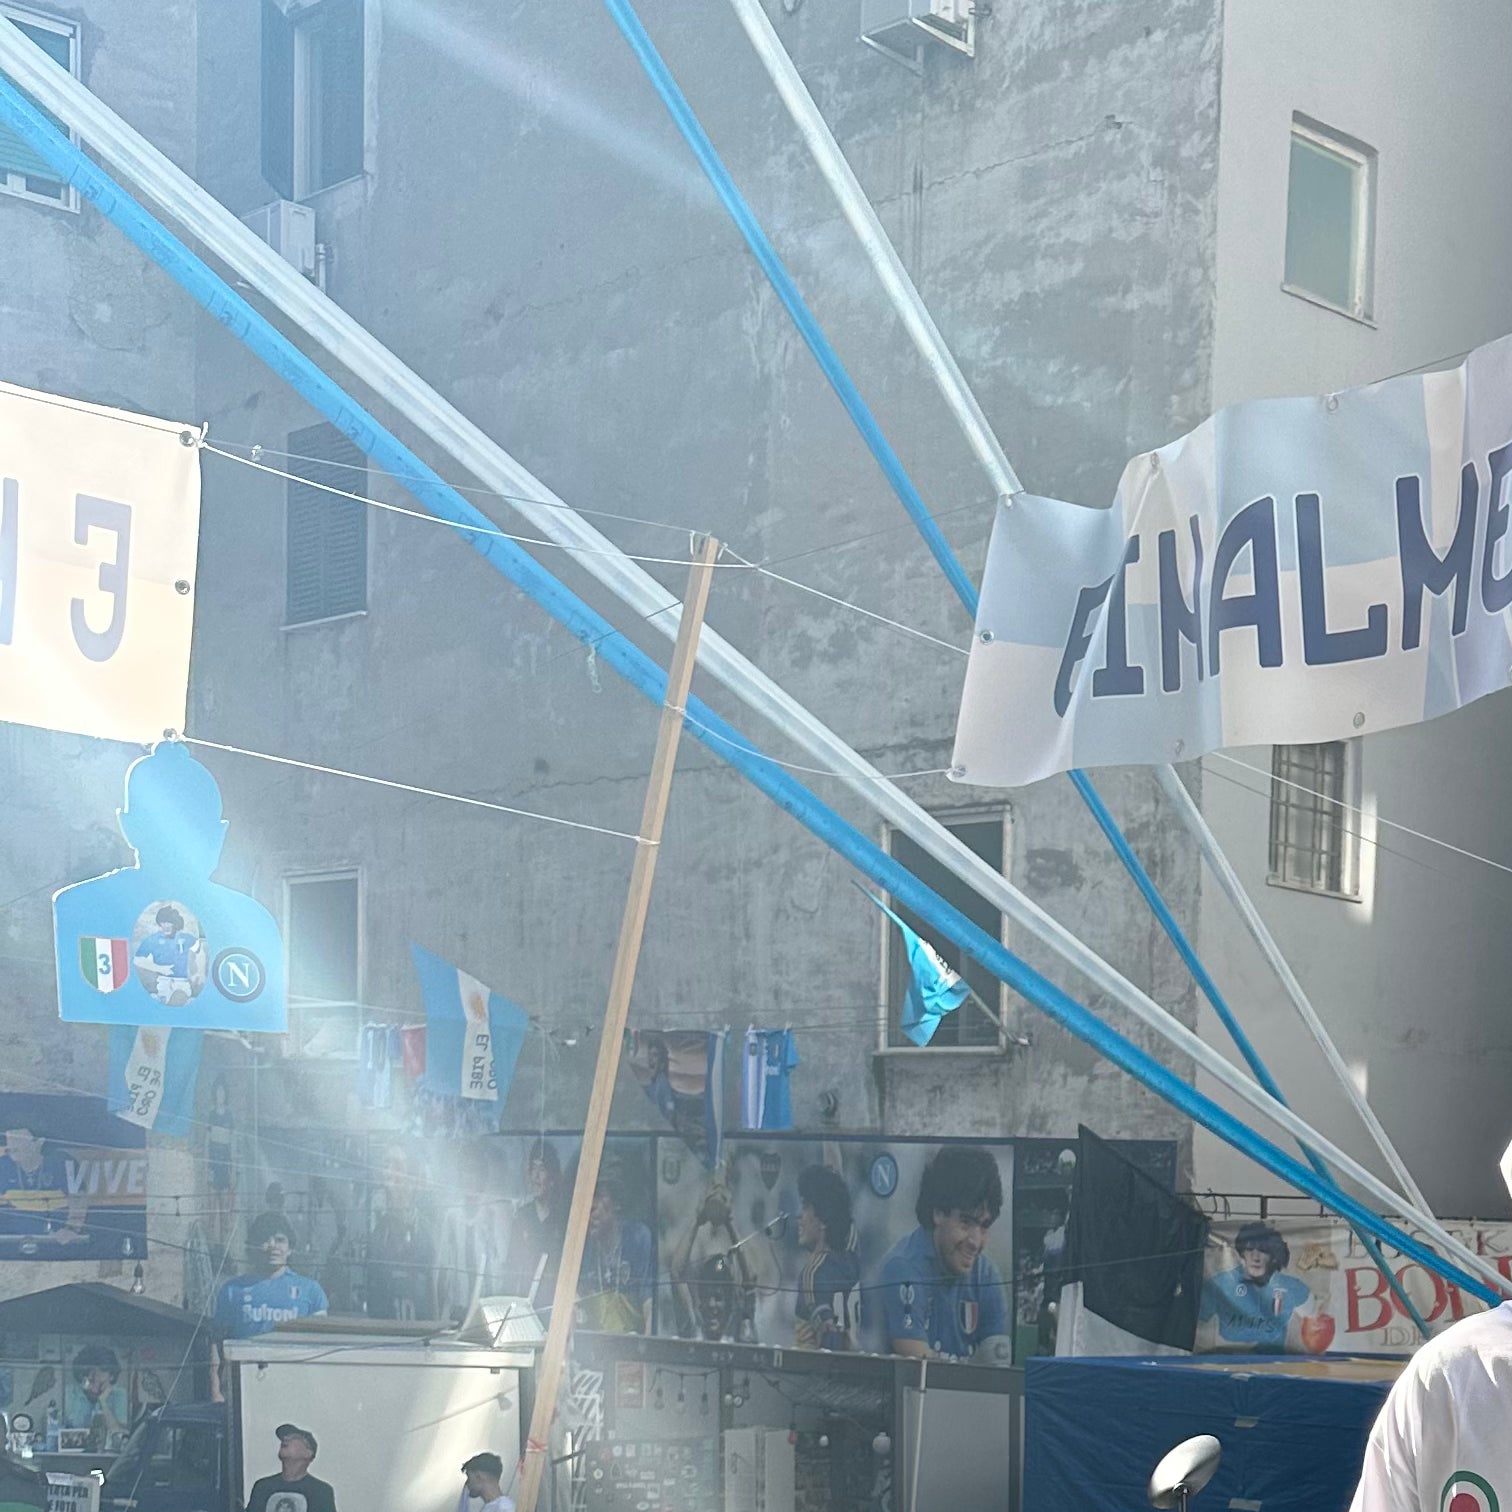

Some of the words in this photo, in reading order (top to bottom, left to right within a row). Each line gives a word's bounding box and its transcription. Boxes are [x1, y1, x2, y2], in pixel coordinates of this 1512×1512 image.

[226, 962, 250, 989] N
[64, 1158, 148, 1195] VIVE
[877, 1164, 892, 1189] N
